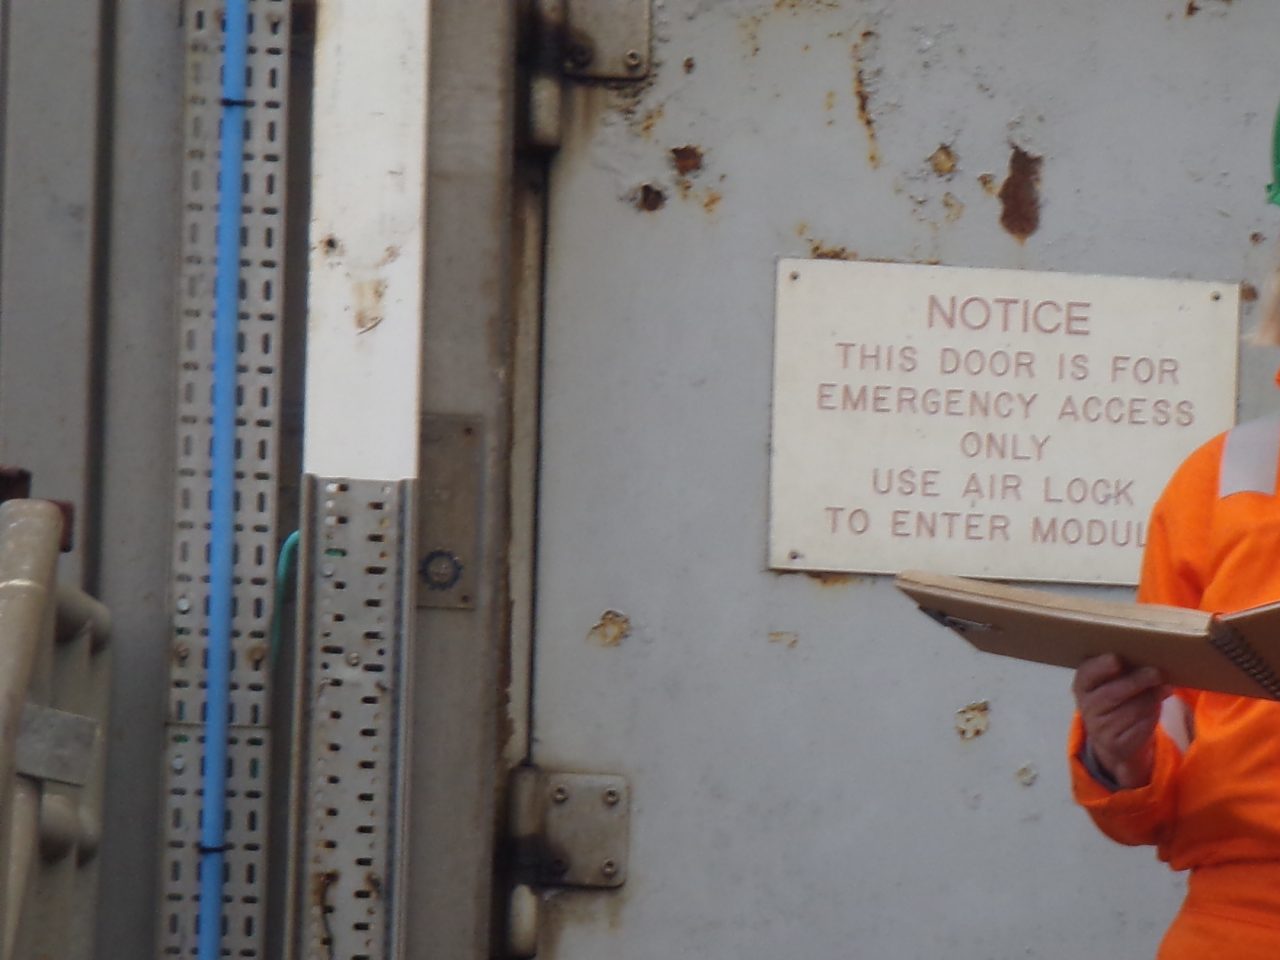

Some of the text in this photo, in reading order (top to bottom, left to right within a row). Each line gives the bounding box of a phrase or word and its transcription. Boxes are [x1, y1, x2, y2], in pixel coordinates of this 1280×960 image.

[927, 296, 1092, 336] NOTICE
[836, 343, 1180, 385] THIS DOOR IS FOR
[816, 383, 1195, 427] EMERGENCY ACCESS
[960, 431, 1051, 461] ONLY
[872, 468, 1135, 506] USE AIR LOCK
[825, 507, 870, 536] TO
[891, 510, 1011, 542] ENTER
